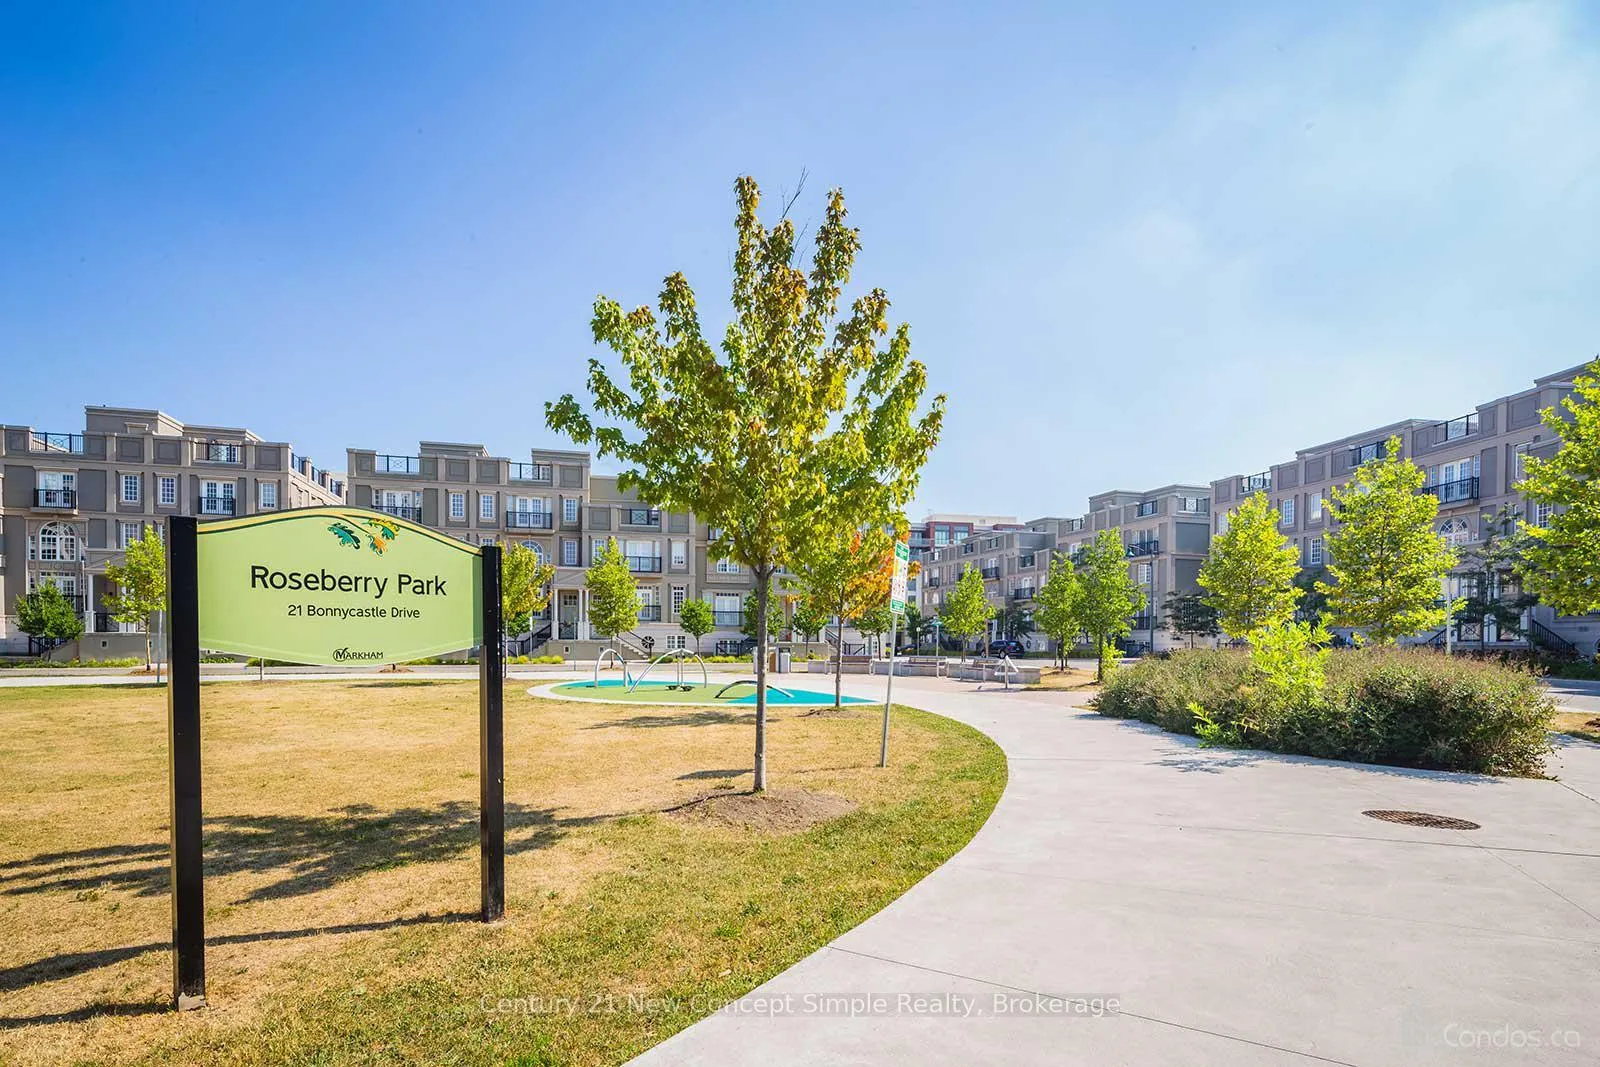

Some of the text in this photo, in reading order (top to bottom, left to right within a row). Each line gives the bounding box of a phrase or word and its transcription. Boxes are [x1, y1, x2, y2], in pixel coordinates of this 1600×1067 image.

[251, 565, 447, 599] Roseberry Park
[287, 604, 420, 620] 21 Bonnycastle Drive
[332, 648, 384, 662] MARKHAM
